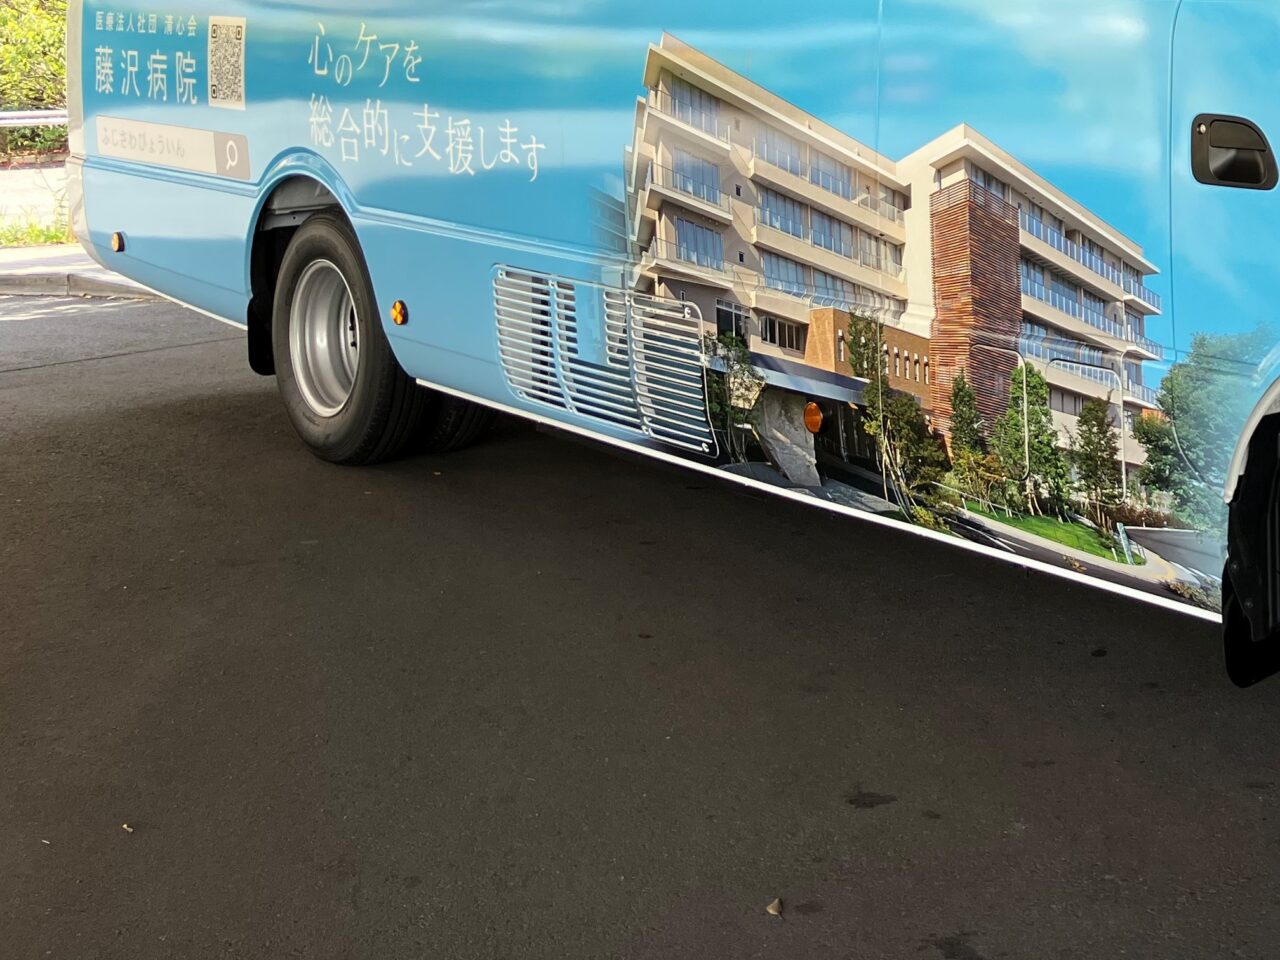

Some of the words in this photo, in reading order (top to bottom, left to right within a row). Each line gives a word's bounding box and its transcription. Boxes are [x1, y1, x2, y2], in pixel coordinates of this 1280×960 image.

[95, 11, 158, 34] 医療法人社団
[164, 14, 198, 37] 清心会
[308, 22, 422, 87] 心のケアを
[95, 45, 198, 105] 藤沢病院
[309, 93, 546, 182] 総合的に支援します
